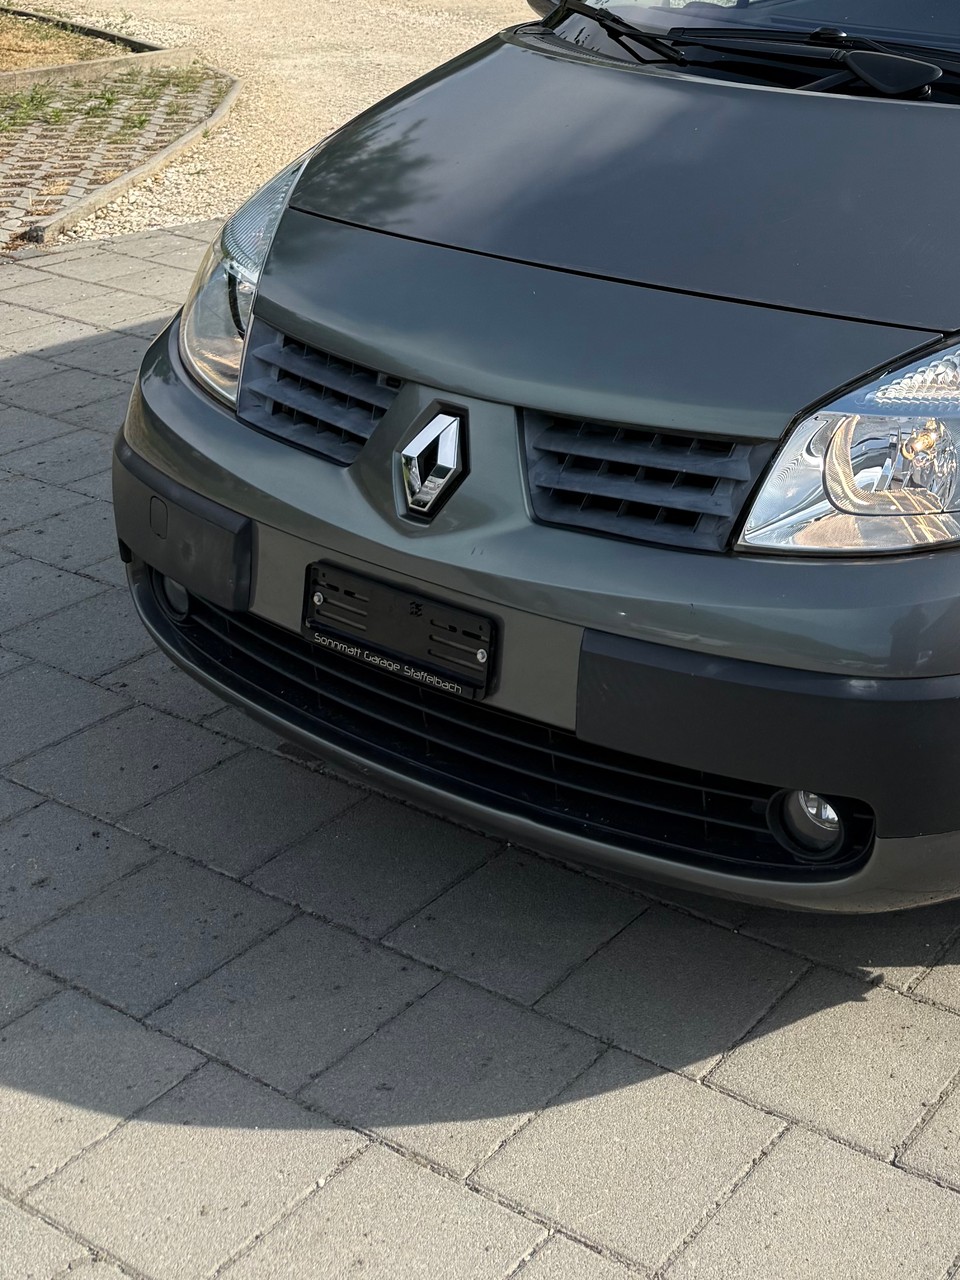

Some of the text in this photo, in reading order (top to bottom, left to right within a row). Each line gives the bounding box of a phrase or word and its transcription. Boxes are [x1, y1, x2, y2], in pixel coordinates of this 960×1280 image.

[314, 632, 462, 695] Sonnmatt Garage Staffelbach
